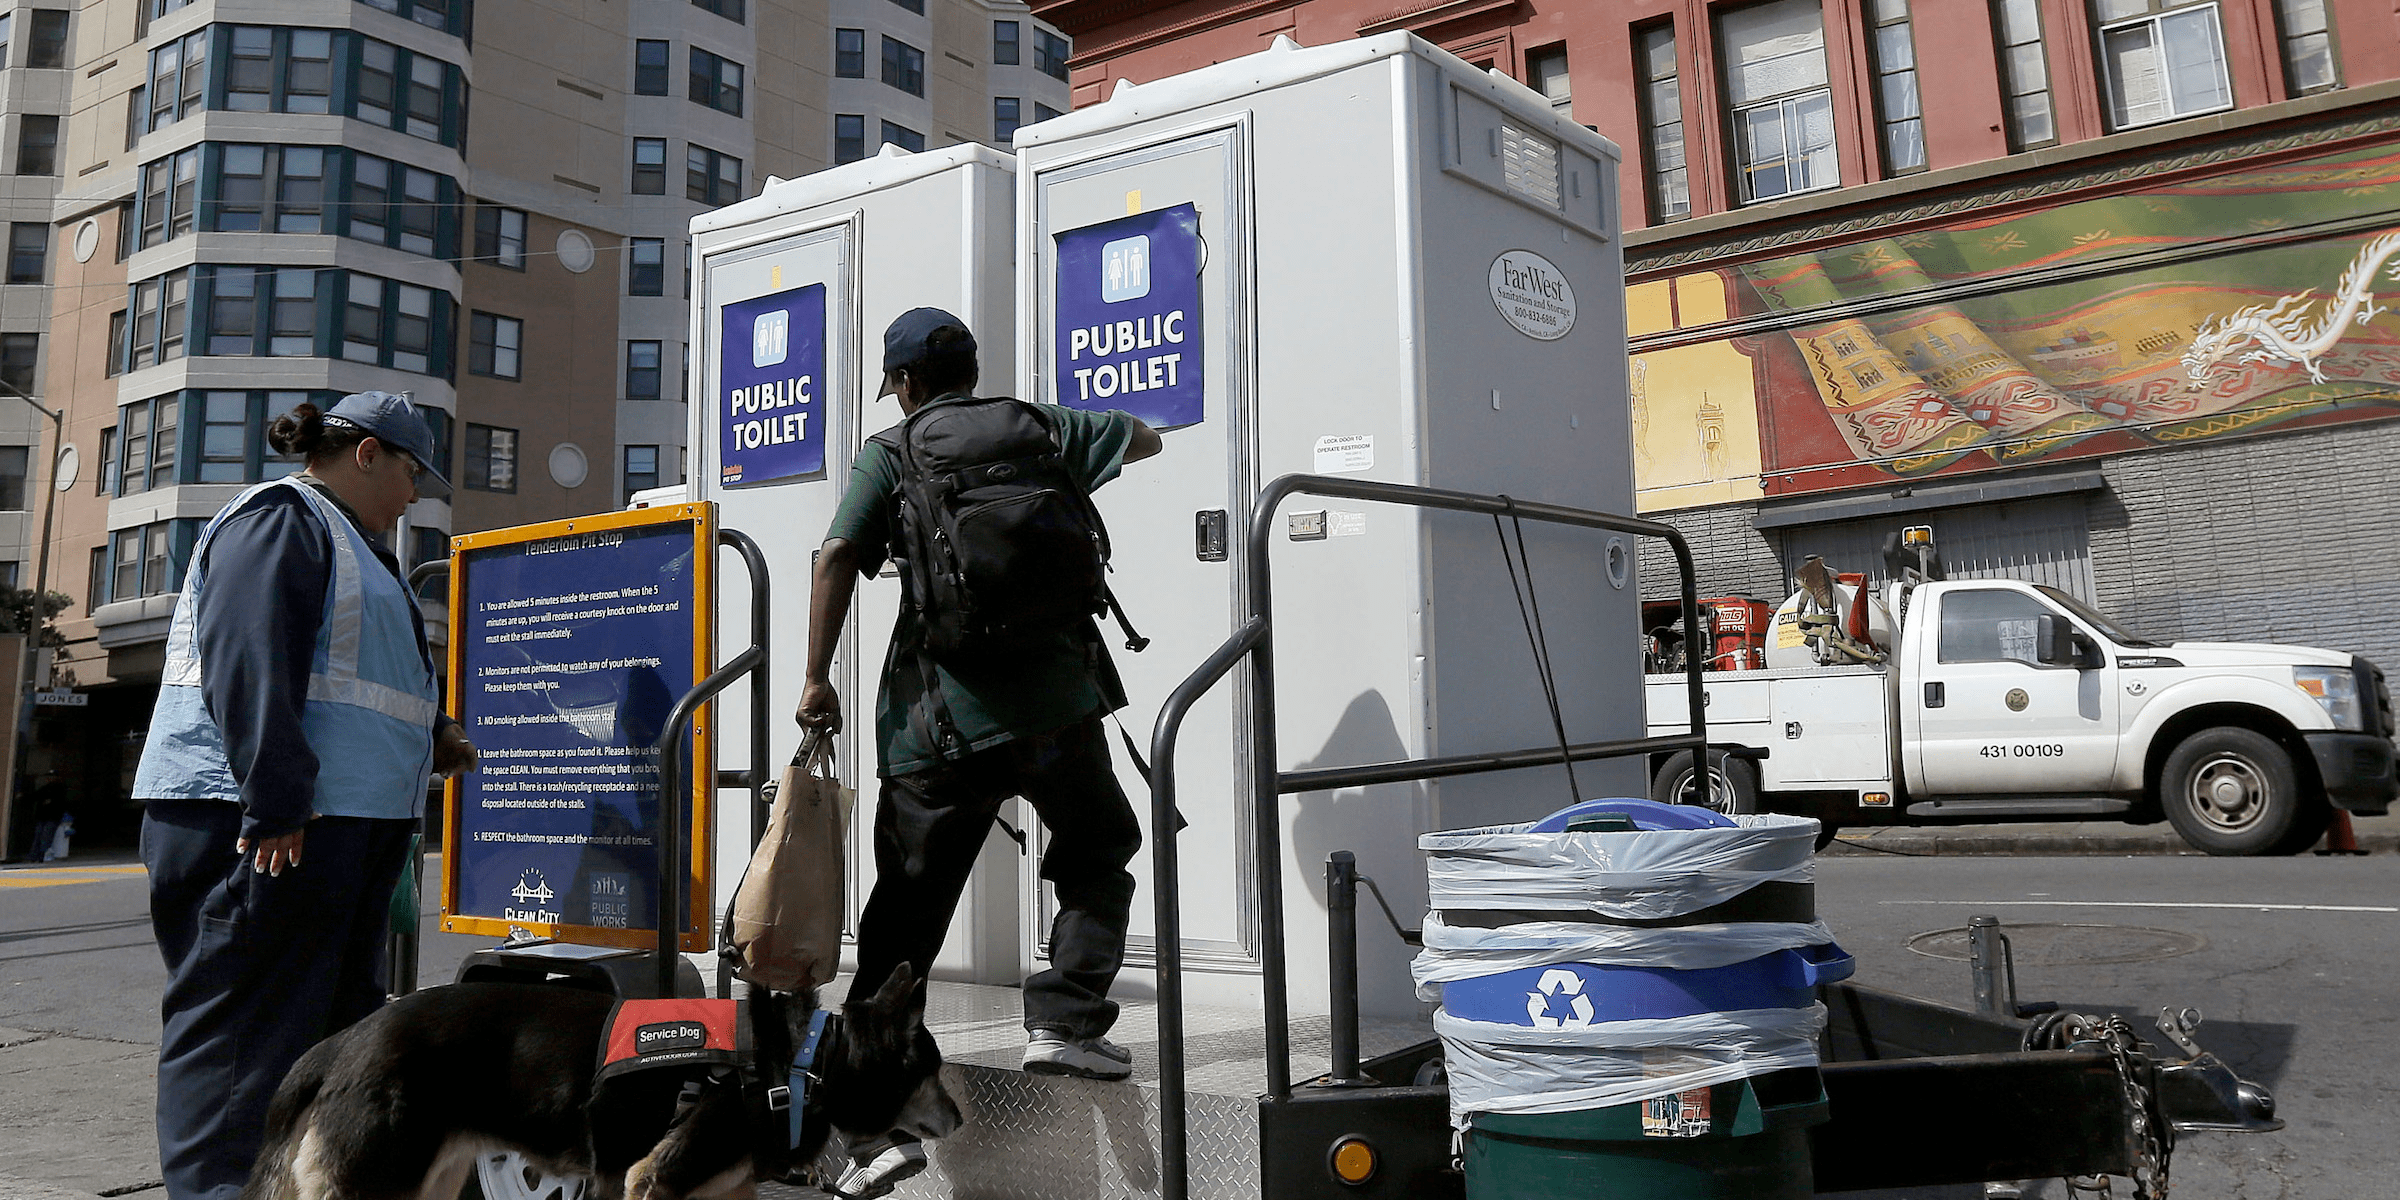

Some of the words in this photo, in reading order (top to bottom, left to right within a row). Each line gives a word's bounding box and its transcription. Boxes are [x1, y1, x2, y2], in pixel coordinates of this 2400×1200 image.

[1070, 310, 1185, 361] PUBLIC
[1074, 353, 1182, 400] TOILET
[731, 375, 812, 417] PUBLIC
[732, 412, 808, 451] TOILET
[525, 537, 580, 556] Tenderloin
[582, 534, 597, 550] Pit
[598, 531, 624, 549] Stop
[487, 602, 498, 611] You
[498, 602, 507, 610] are
[507, 598, 530, 609] allowed
[530, 597, 535, 607] 5
[535, 596, 559, 606] minutes
[560, 593, 578, 604] inside
[579, 592, 589, 602] the
[590, 590, 620, 601] restroom.
[621, 587, 641, 597] When
[641, 586, 653, 596] the
[654, 584, 659, 594] 5
[486, 618, 508, 627] minutes
[508, 617, 517, 625] are
[518, 616, 528, 626] up,
[528, 615, 540, 626] you
[541, 612, 552, 622] will
[552, 611, 573, 622] receive
[574, 611, 579, 619] a
[579, 608, 606, 619] courtesy
[607, 606, 626, 617] knock
[626, 606, 635, 615] on
[636, 603, 647, 614] the
[648, 602, 664, 613] door
[665, 600, 679, 612] and
[486, 635, 500, 643] must
[500, 633, 510, 643] exit
[511, 632, 521, 641] the
[521, 631, 534, 641] stall
[534, 627, 573, 640] immediately.
[478, 667, 485, 677] 2.
[485, 666, 510, 676] Monitors
[511, 666, 520, 674] are
[521, 665, 531, 674] not
[531, 662, 561, 675] permitted
[561, 663, 568, 671] to
[569, 660, 588, 671] watch
[589, 661, 600, 671] any
[601, 658, 608, 669] of
[609, 660, 624, 671] your
[624, 656, 662, 668] belongings.
[485, 682, 503, 692] Please
[503, 682, 517, 693] keep
[517, 681, 533, 691] them
[533, 680, 546, 690] with
[547, 681, 560, 691] you.
[40, 695, 83, 704] JONES
[477, 715, 483, 726] 3.
[484, 715, 494, 725] NO
[494, 714, 517, 727] smoking
[517, 714, 540, 724] allowed
[540, 713, 558, 723] inside
[559, 714, 570, 723] the
[570, 712, 602, 722] bathroom
[483, 749, 499, 758] Leave
[500, 748, 509, 758] the
[510, 747, 538, 758] bathroom
[539, 749, 556, 759] space
[557, 750, 564, 758] as
[565, 749, 576, 759] you
[577, 746, 595, 757] found
[604, 746, 625, 756] Please
[625, 745, 640, 757] help
[641, 747, 649, 756] us
[1980, 745, 2006, 758] 431
[2013, 744, 2064, 757] 00109
[483, 765, 492, 775] the
[493, 766, 509, 776] space
[510, 765, 530, 775] CLEAN.
[530, 765, 542, 774] You
[543, 765, 558, 774] must
[559, 766, 582, 774] remove
[582, 764, 616, 776] everything
[616, 763, 630, 774] that
[631, 765, 644, 775] you
[482, 782, 494, 791] into
[494, 782, 504, 791] the
[505, 781, 518, 791] stall.
[519, 781, 536, 791] There
[536, 782, 542, 791] is
[547, 780, 592, 794] trash/recycling
[592, 781, 626, 793] receptacle
[626, 781, 639, 792] and
[639, 783, 645, 791] a
[482, 798, 504, 809] disposal
[505, 798, 526, 809] located
[526, 799, 549, 809] outside
[549, 798, 556, 808] of
[556, 798, 568, 808] the
[568, 798, 586, 809] stalls.
[474, 831, 480, 841] 5.
[481, 831, 505, 842] RESPECT
[506, 832, 516, 842] the
[516, 832, 546, 843] bathroom
[546, 835, 564, 845] space
[564, 833, 577, 844] and
[577, 833, 589, 844] the
[589, 835, 614, 845] monitor
[615, 835, 623, 845] at
[623, 835, 631, 845] all
[631, 836, 653, 846] times.
[592, 902, 628, 917] PUBLIC
[592, 915, 628, 930] WORKS
[640, 1029, 677, 1043] Service
[680, 1026, 700, 1040] Dog
